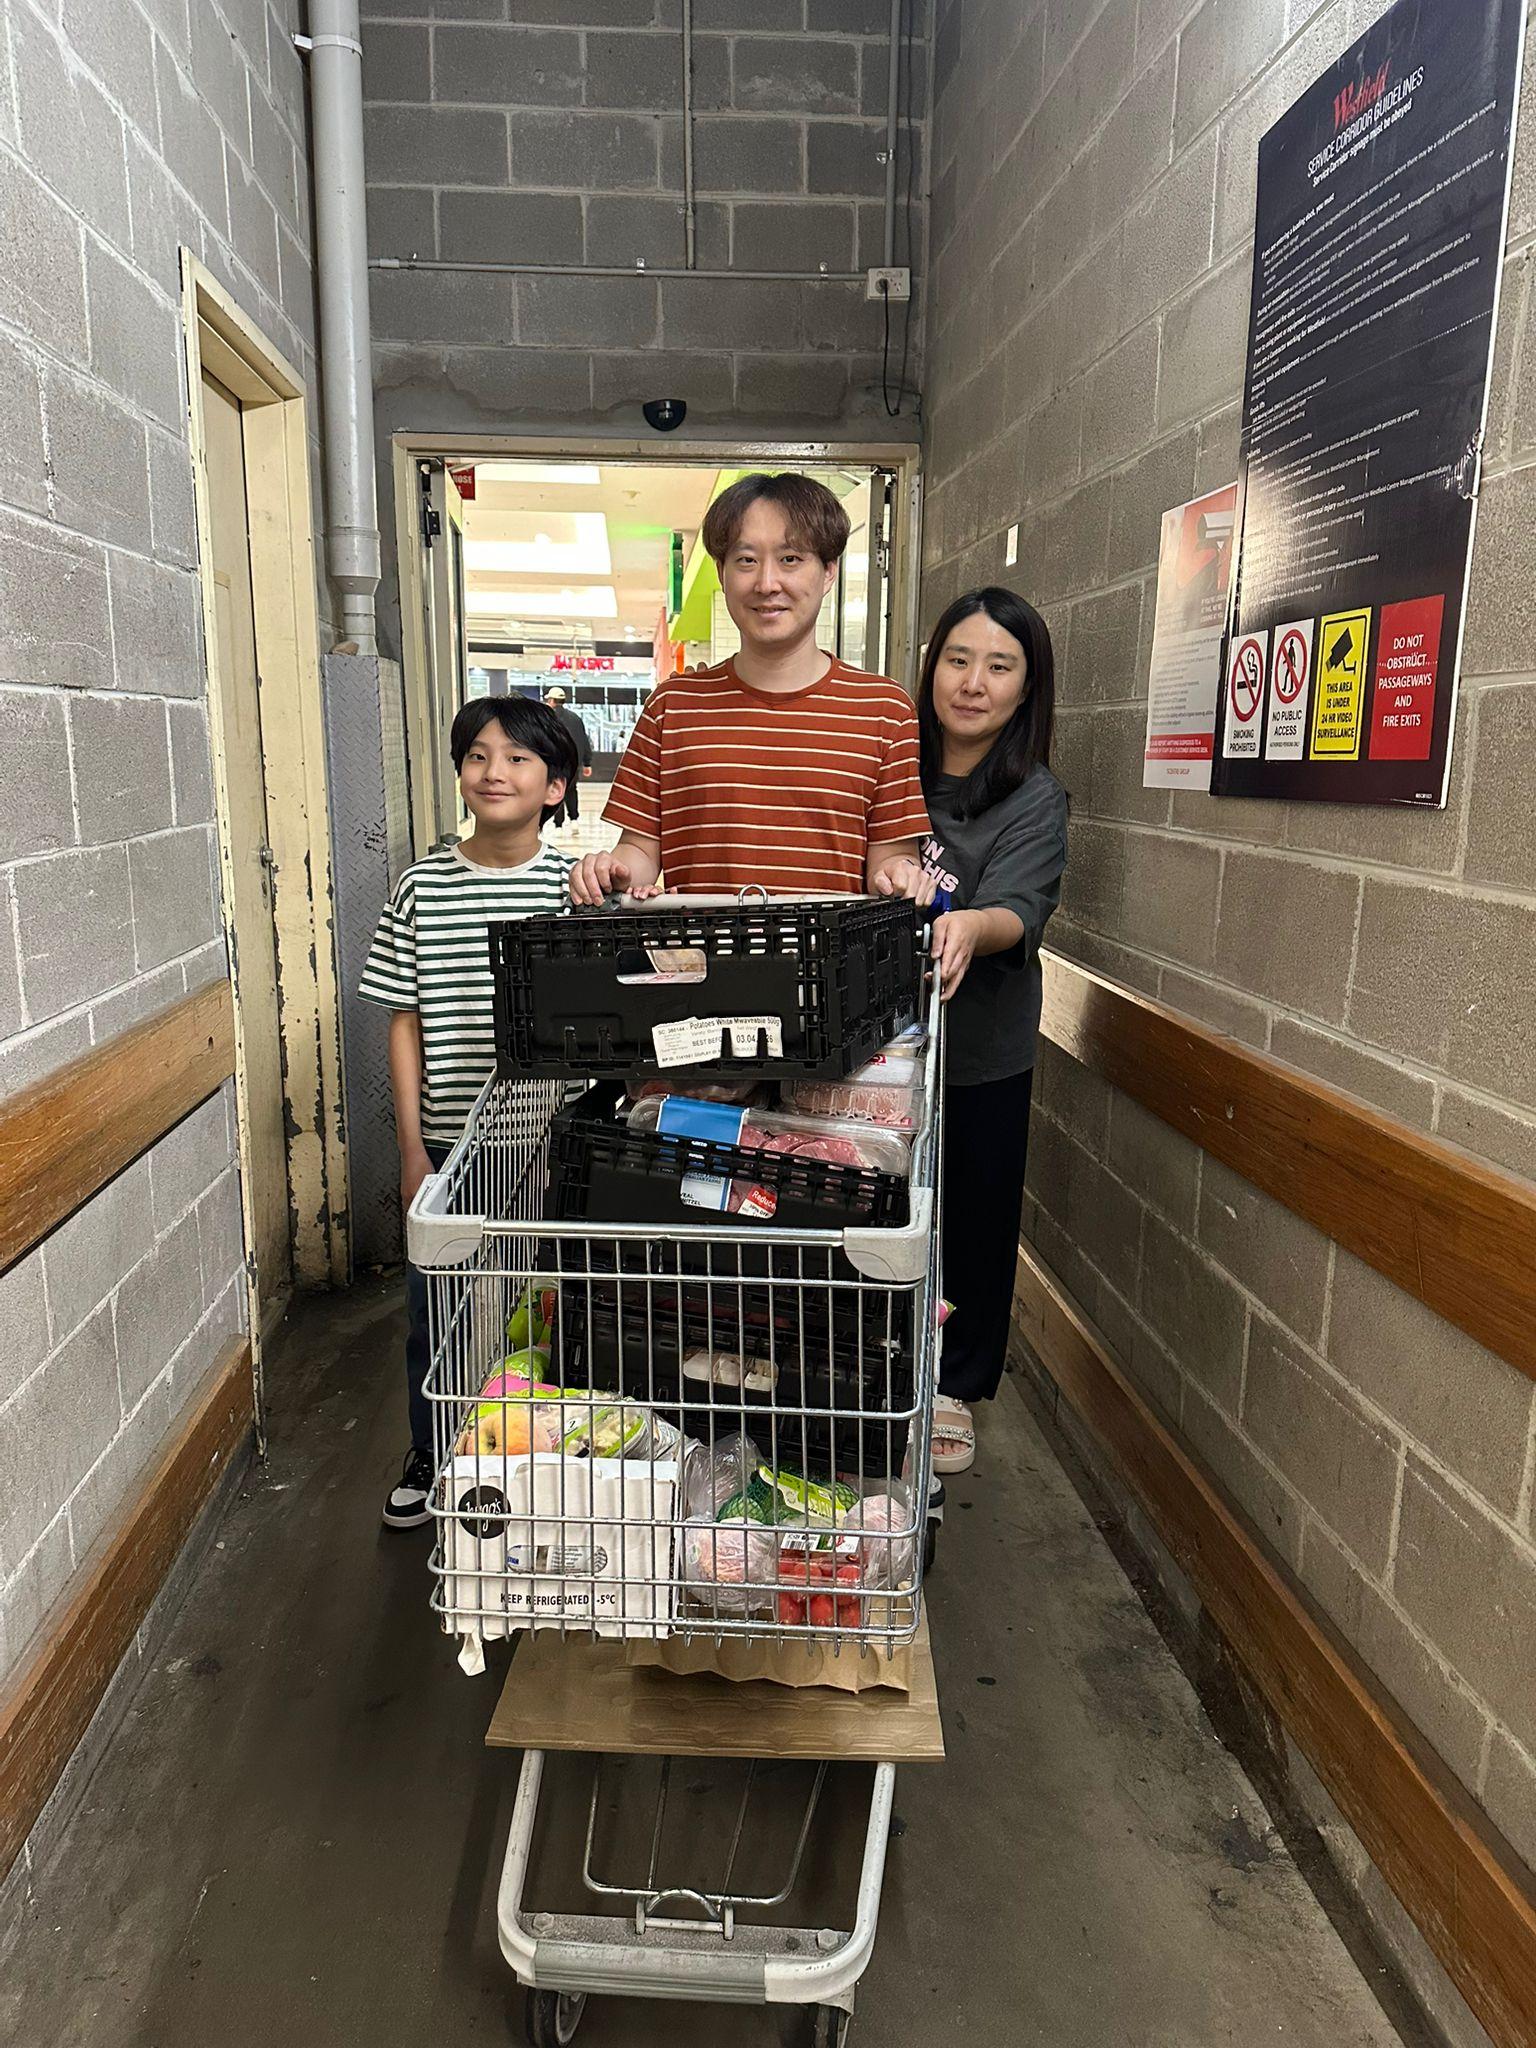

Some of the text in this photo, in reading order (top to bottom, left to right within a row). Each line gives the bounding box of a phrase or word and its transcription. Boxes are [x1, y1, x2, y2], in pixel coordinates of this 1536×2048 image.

[1333, 57, 1392, 134] Westfield
[1307, 66, 1424, 178] SERVICE CORRIDOR GUIDELINES
[1312, 167, 1330, 187] Service
[1349, 134, 1370, 157] signage
[1369, 121, 1384, 140] must
[1390, 97, 1412, 123] obeyed
[1393, 634, 1424, 650] DO NOT
[1386, 653, 1427, 670] OBSTRUCT
[1327, 681, 1353, 694] THIS AREA
[1378, 673, 1432, 689] PASSAGEWAYS
[1326, 697, 1350, 709] IS UNDER
[1394, 695, 1412, 708] AND
[1272, 710, 1302, 721] NO PUBLIC
[1321, 712, 1352, 724] 24 HR VIDEO
[1383, 714, 1421, 727] FIRE EXITS
[1233, 729, 1255, 739] SMOKING
[1274, 725, 1297, 736] ACCESS
[1317, 727, 1355, 738] SURVEILLANCE
[1229, 742, 1256, 752] PROHIBITED
[922, 856, 959, 893] HIS
[716, 1018, 733, 1026] White
[767, 1018, 780, 1026] 500g
[692, 1039, 707, 1047] BEST
[752, 1190, 776, 1209] Reduce
[500, 1593, 522, 1604] KEEP
[526, 1594, 589, 1606] REFRIGERATED
